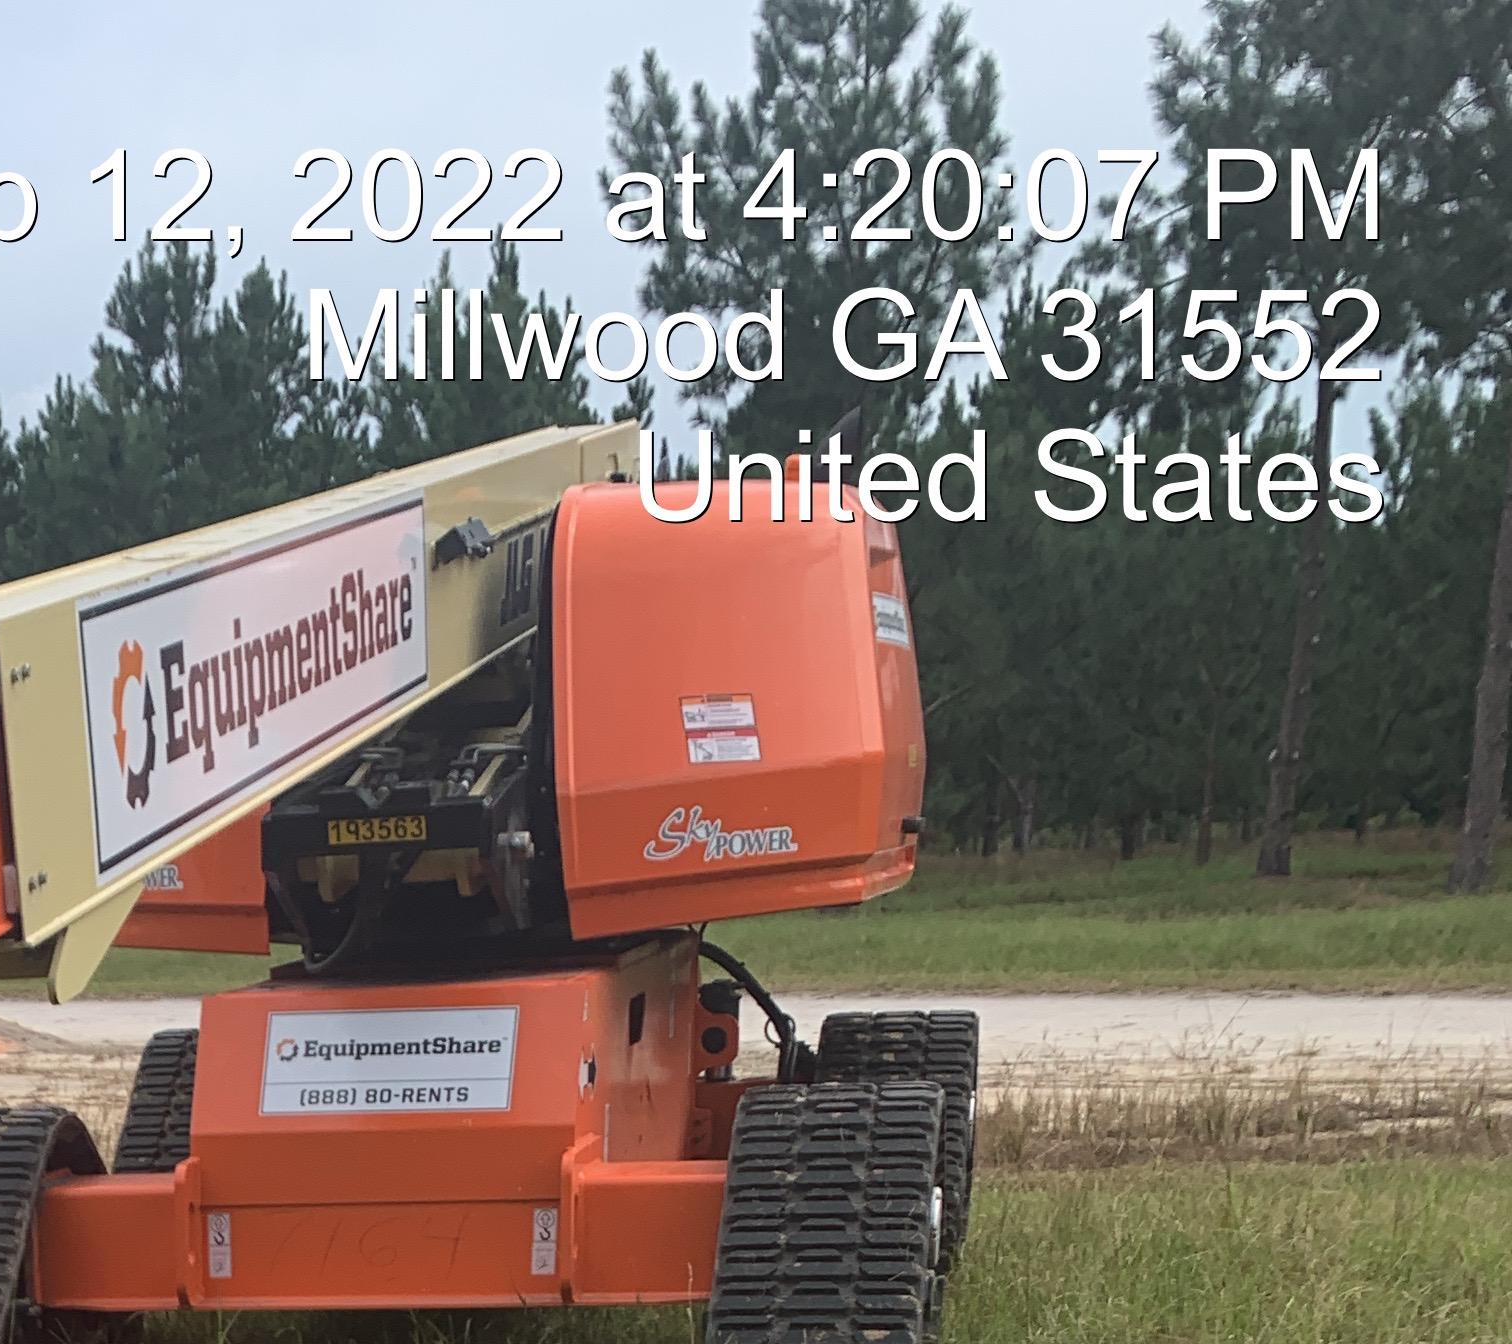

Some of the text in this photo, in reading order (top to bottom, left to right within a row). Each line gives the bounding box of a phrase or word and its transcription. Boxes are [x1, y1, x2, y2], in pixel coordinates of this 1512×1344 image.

[159, 568, 413, 774] EquipmentShare
[330, 816, 423, 842] 193563
[303, 1036, 502, 1061] EquipmentShare
[299, 1086, 470, 1107] (888) 80-RENTS
